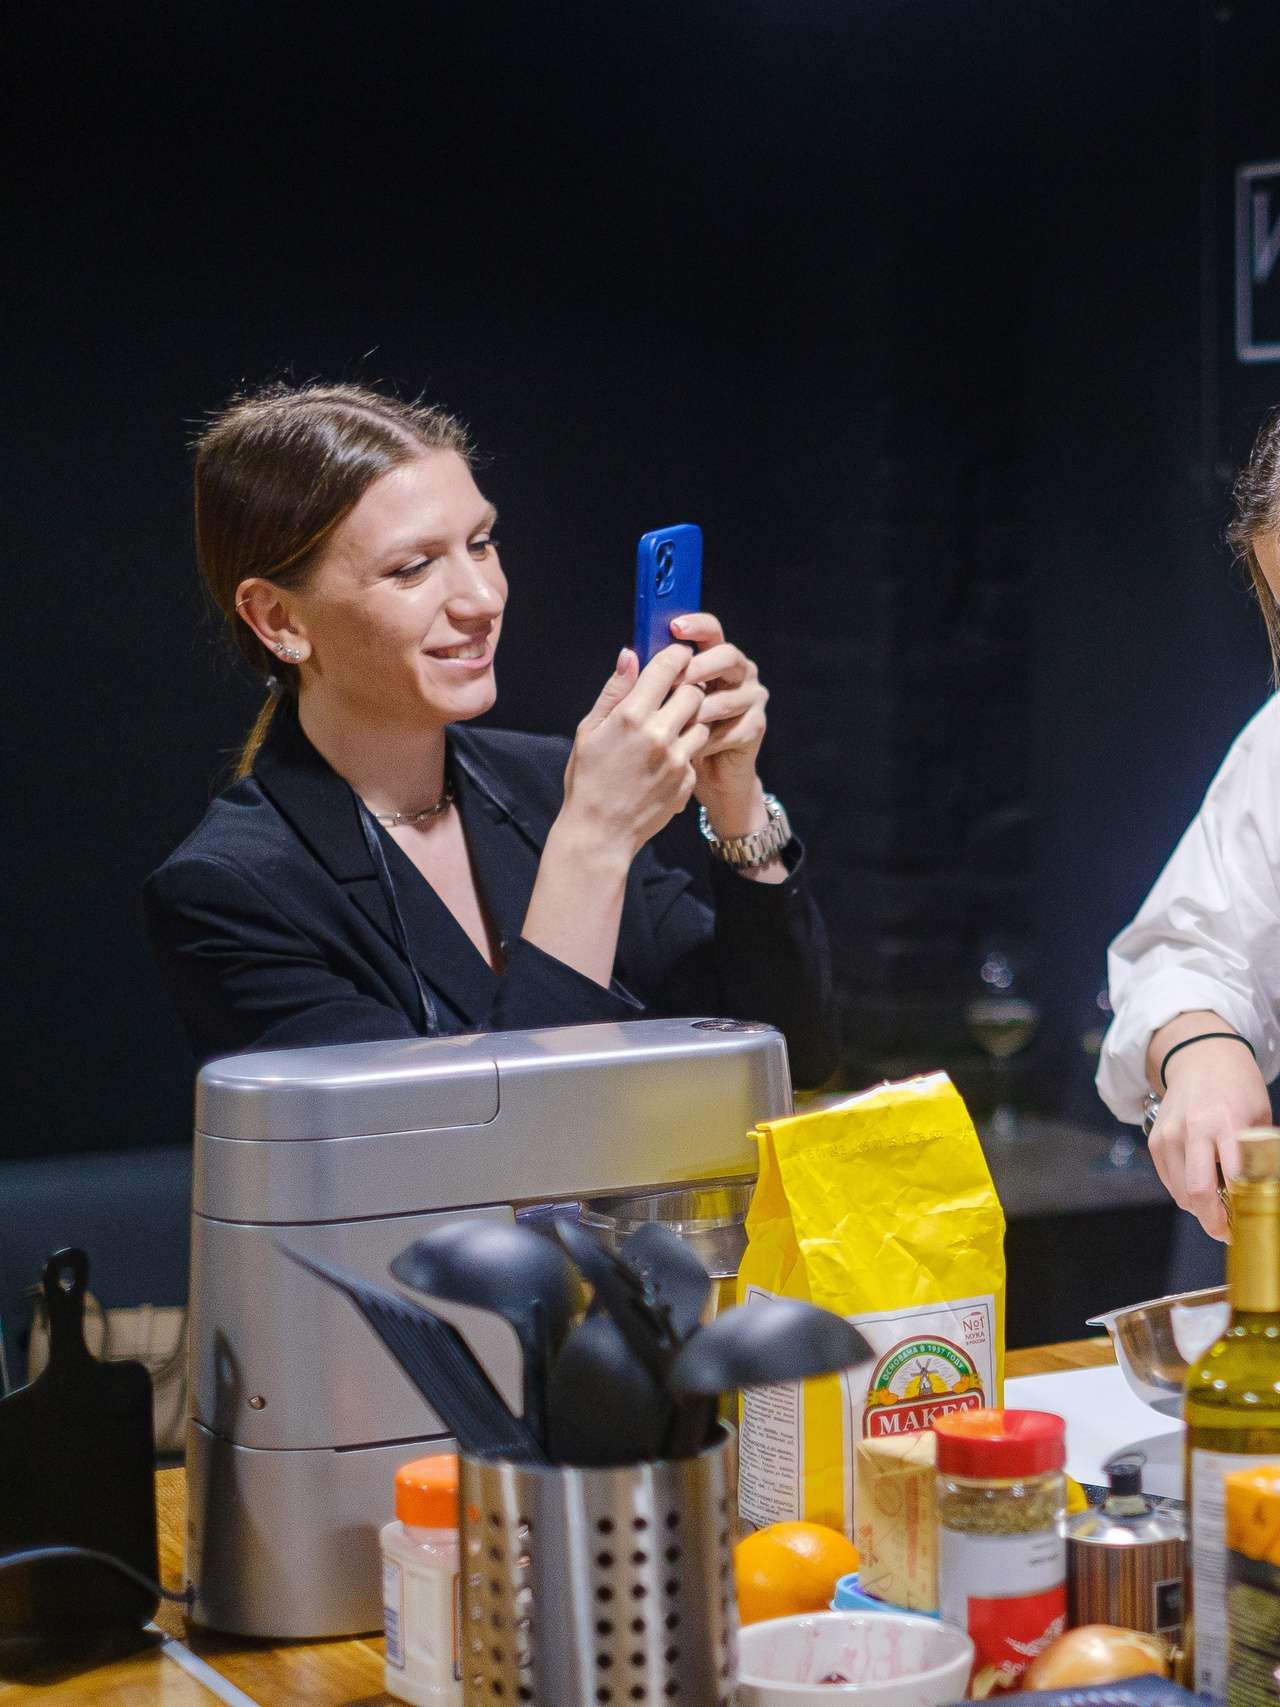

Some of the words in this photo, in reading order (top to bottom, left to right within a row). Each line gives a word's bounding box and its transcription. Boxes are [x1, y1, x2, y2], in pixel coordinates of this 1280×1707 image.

[965, 1332, 985, 1340] МУКА
[882, 1345, 919, 1381] ОСНОВАНА
[928, 1345, 945, 1355] 1937
[946, 1352, 965, 1369] ГОДУ
